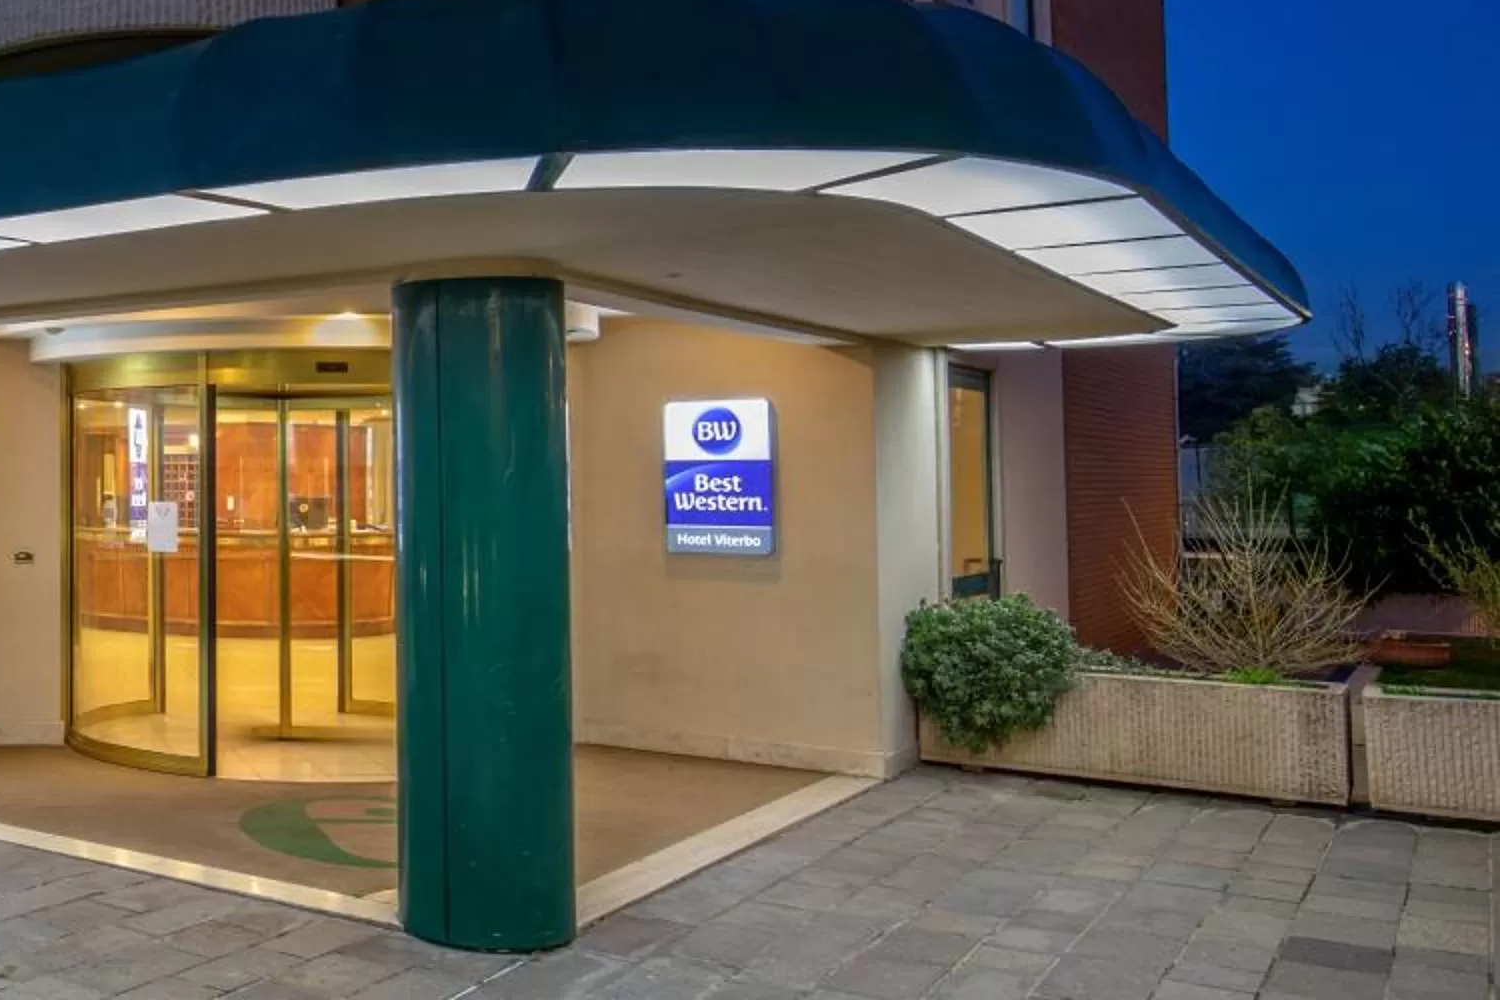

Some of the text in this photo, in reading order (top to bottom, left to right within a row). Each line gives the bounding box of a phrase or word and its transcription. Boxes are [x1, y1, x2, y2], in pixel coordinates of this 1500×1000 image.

[697, 420, 738, 441] BW
[694, 472, 743, 493] Best
[677, 532, 761, 547] Hotel Viterbo
